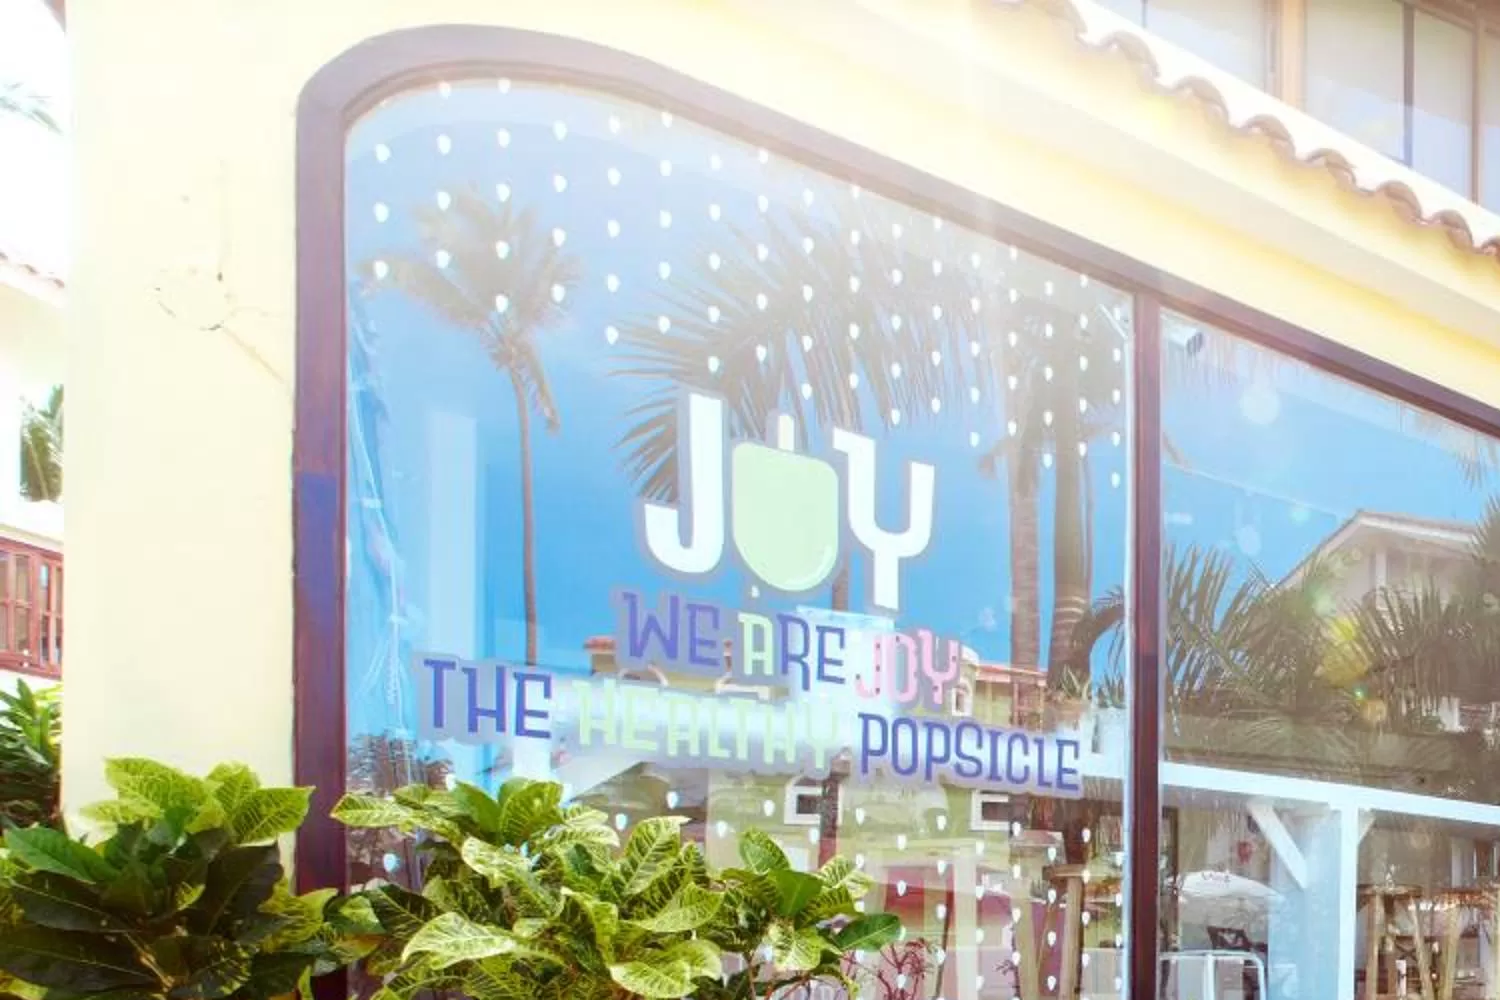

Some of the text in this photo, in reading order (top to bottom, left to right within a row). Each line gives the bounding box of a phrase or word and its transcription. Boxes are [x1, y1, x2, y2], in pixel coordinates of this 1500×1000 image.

[624, 592, 959, 705] WE ARE JOY
[423, 658, 1080, 792] THE HEALTHY POPSICLE
